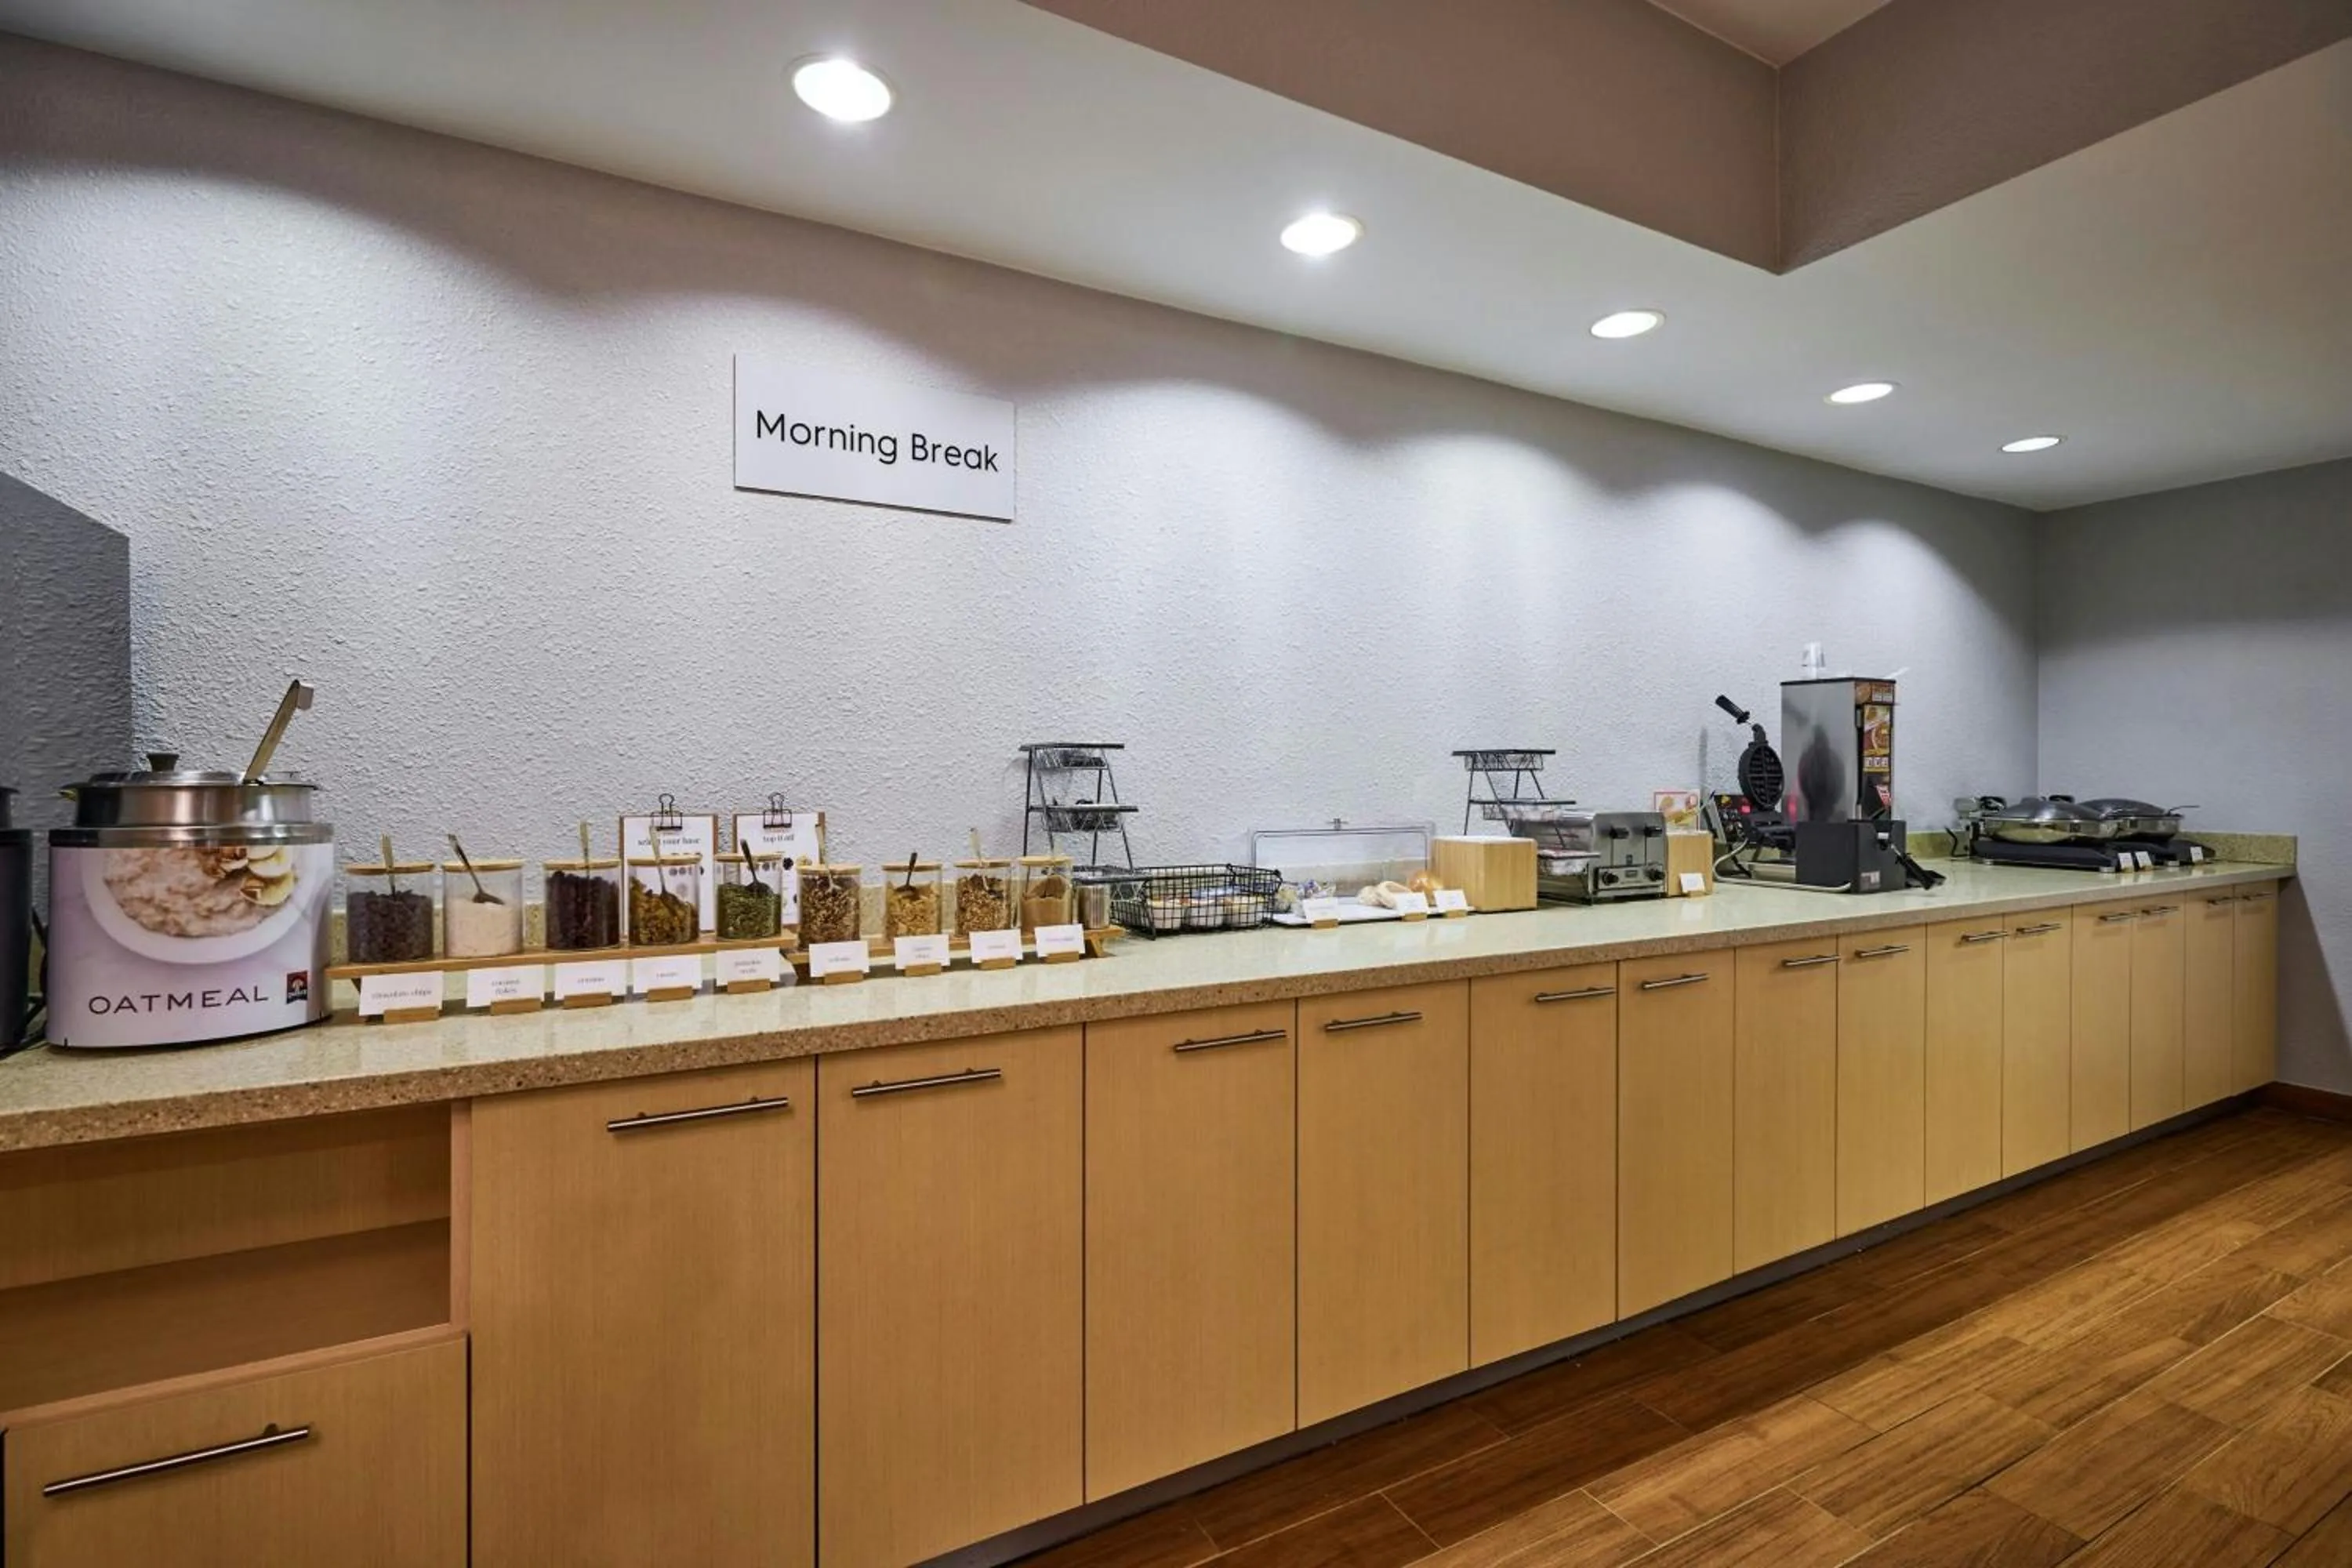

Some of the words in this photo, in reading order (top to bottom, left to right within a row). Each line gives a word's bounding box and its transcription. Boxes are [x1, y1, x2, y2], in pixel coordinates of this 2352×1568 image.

[757, 409, 898, 465] Morning
[911, 433, 999, 472] Break
[637, 837, 661, 846] selet
[88, 985, 270, 1015] OATMEAL
